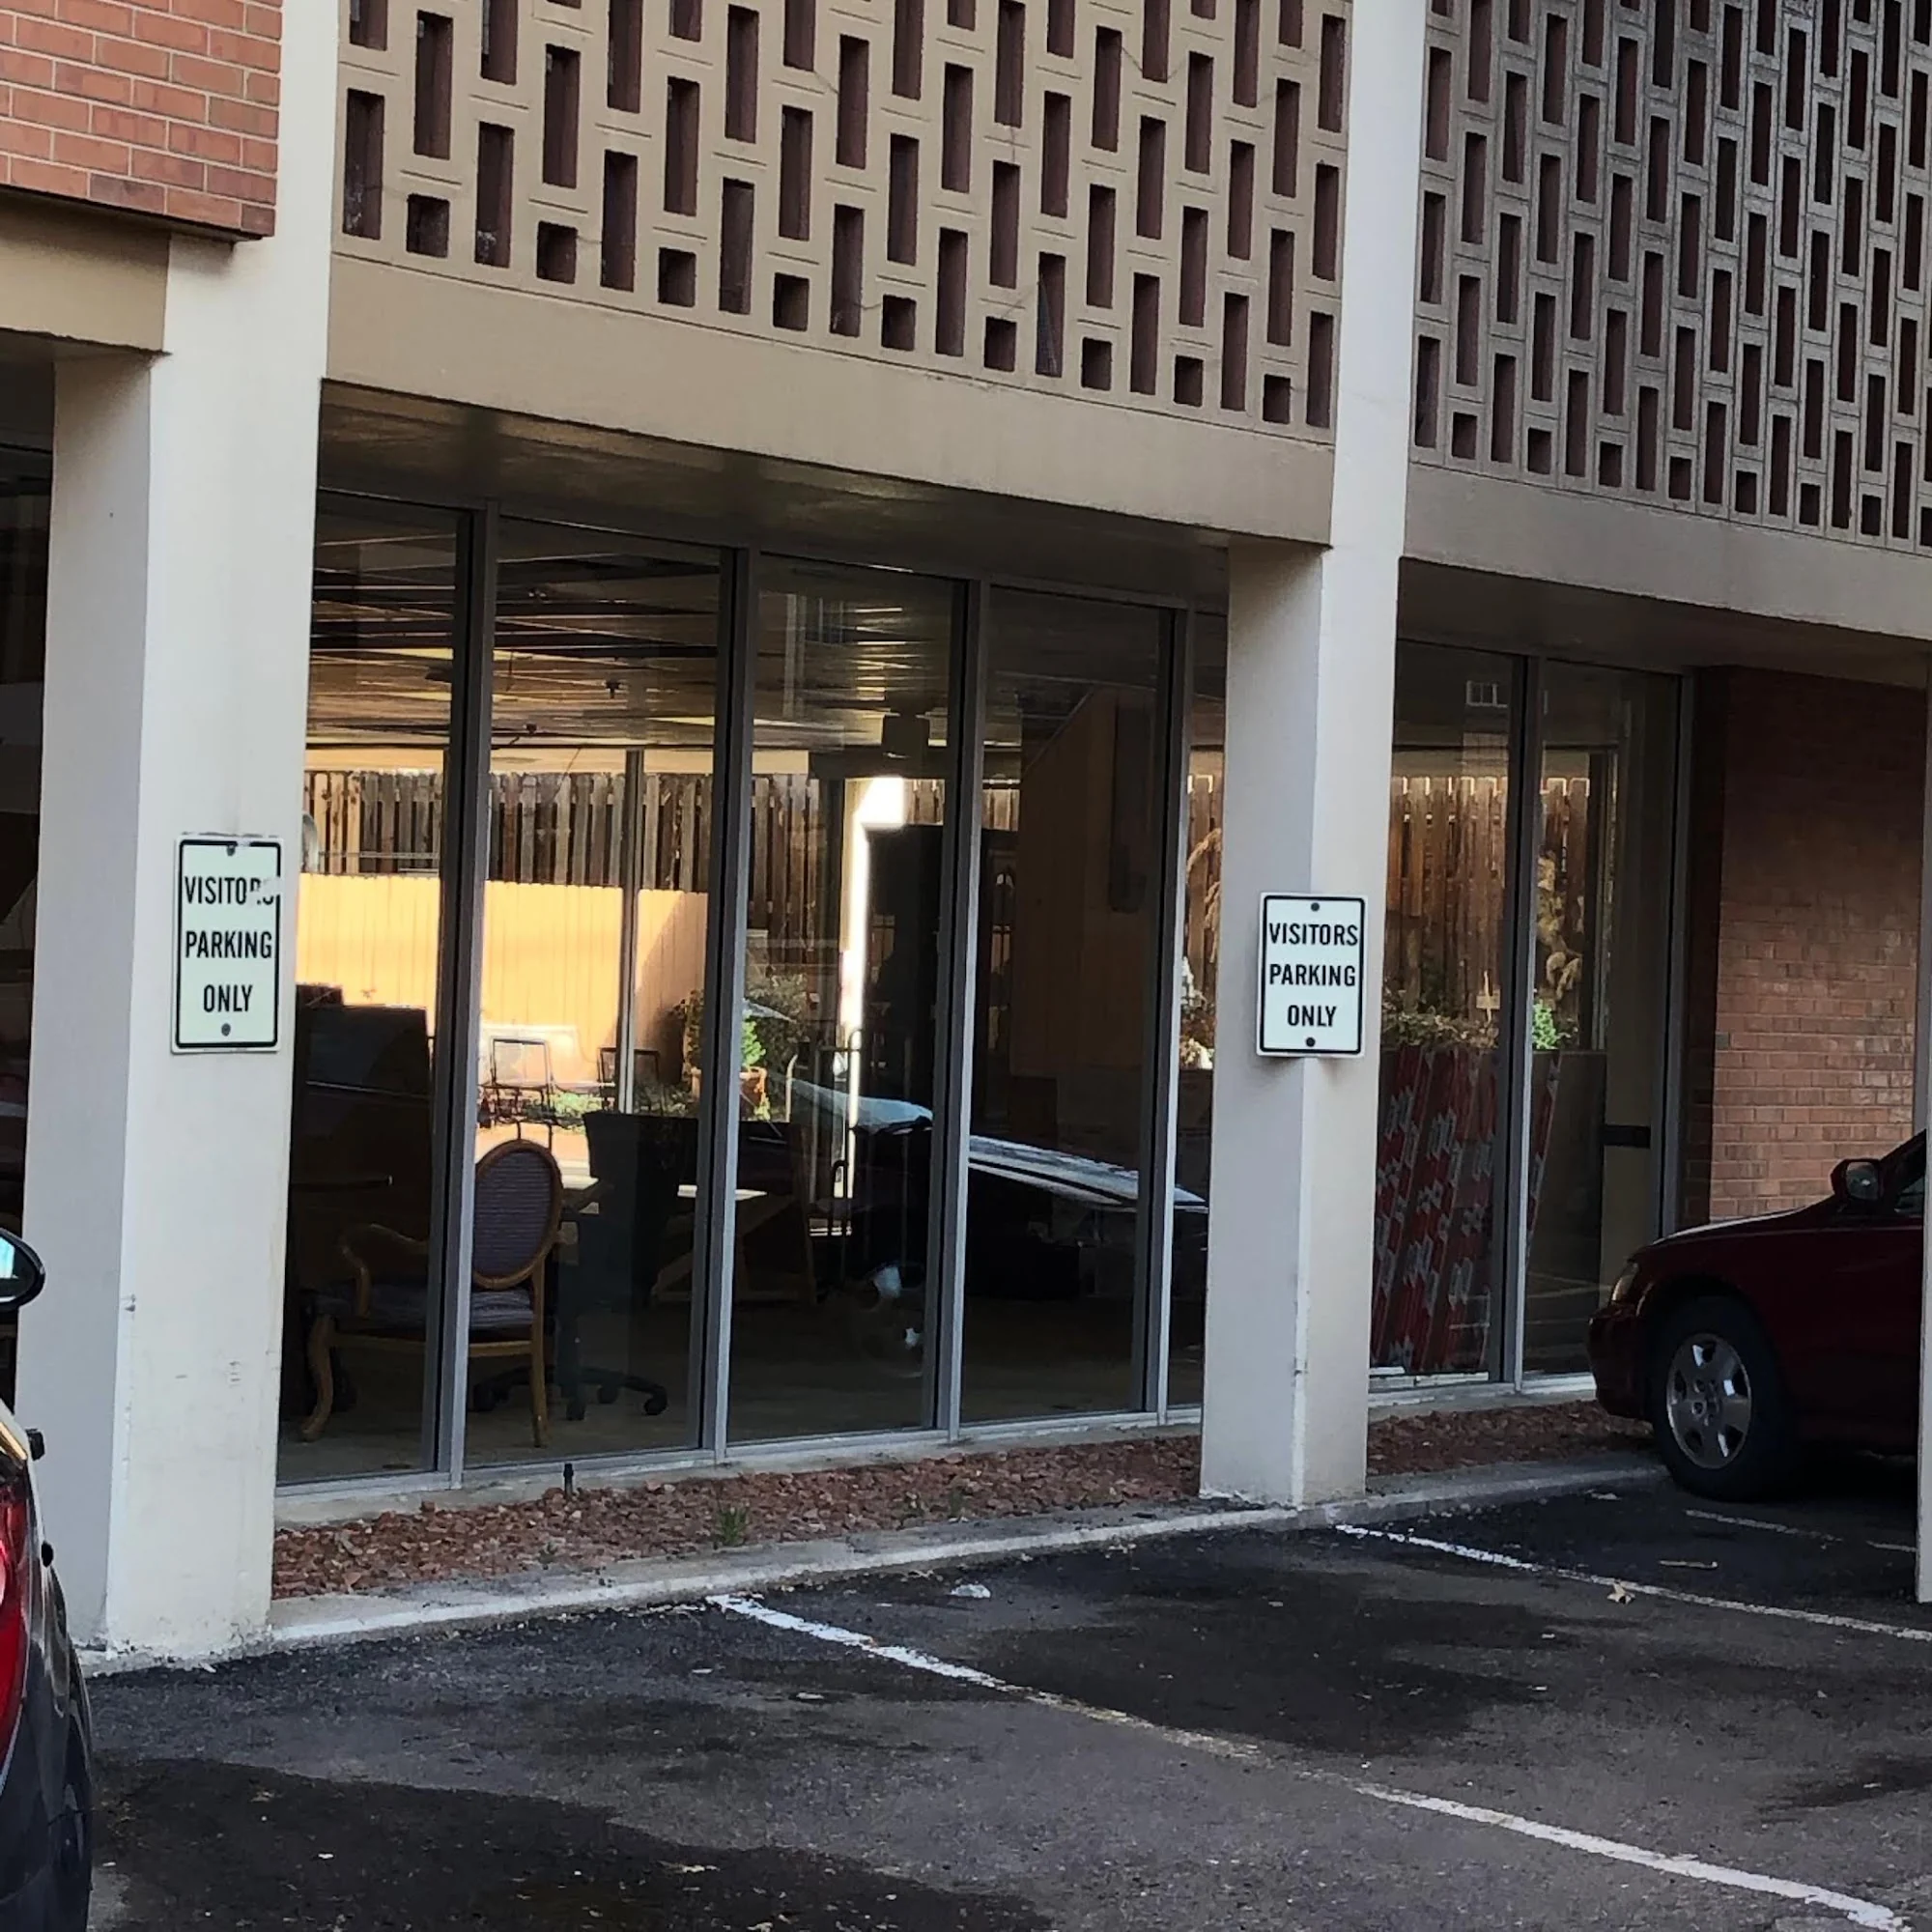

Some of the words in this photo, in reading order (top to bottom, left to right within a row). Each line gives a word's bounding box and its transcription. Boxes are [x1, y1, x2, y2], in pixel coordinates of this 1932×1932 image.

[185, 930, 272, 958] PARKING
[1268, 923, 1358, 946] VISITORS
[1269, 964, 1355, 986] PARKING
[203, 984, 253, 1012] ONLY
[1287, 1005, 1337, 1027] ONLY
